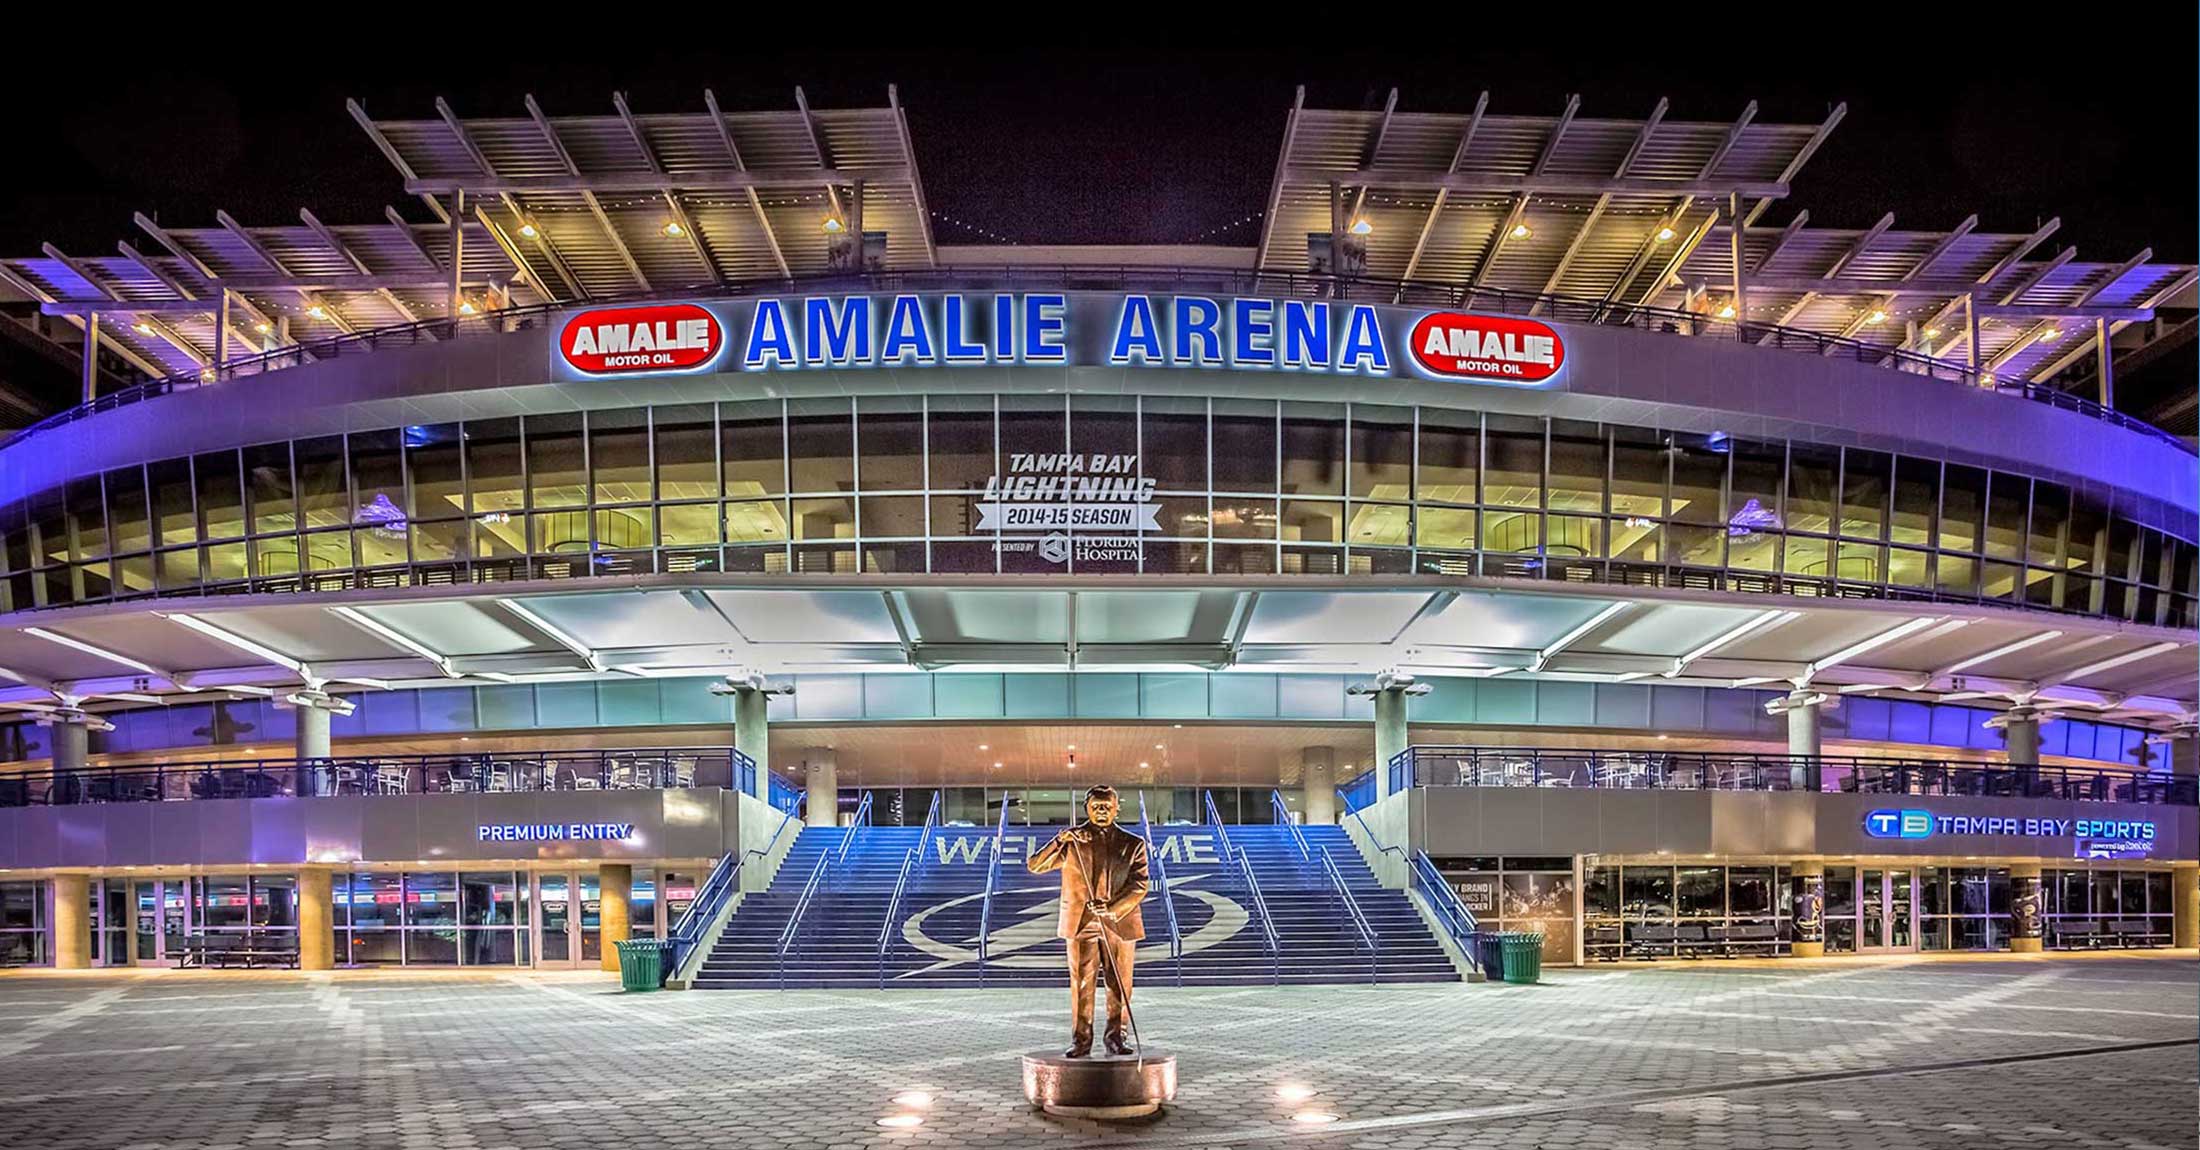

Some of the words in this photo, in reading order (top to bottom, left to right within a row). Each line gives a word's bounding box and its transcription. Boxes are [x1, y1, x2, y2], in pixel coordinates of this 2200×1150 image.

[571, 318, 709, 355] AMALIE
[744, 294, 1065, 364] AMALIE
[1111, 295, 1391, 371] ARENA
[1424, 326, 1554, 365] AMALIE
[605, 356, 650, 367] MOTOR
[653, 354, 674, 364] OIL
[1456, 360, 1500, 372] MOTOR
[1503, 364, 1523, 374] OIL
[1010, 454, 1084, 473] TAMPA
[1089, 454, 1137, 473] BAY
[982, 476, 1157, 501] LIGHTNING
[1007, 508, 1068, 524] 2014-15
[1071, 509, 1132, 524] SEASON
[991, 543, 1025, 551] PSENTED
[1025, 543, 1035, 551] BY
[1076, 536, 1138, 549] FLORIDA
[479, 824, 563, 841] PREMIUM
[570, 823, 631, 839] ENTRY
[1872, 814, 1929, 833] TB
[1937, 816, 2018, 836] TAMPA
[2025, 818, 2068, 836] BAY
[2075, 820, 2154, 839] SPORTS
[936, 835, 1220, 864] WELME
[1461, 883, 1488, 892] BRAND
